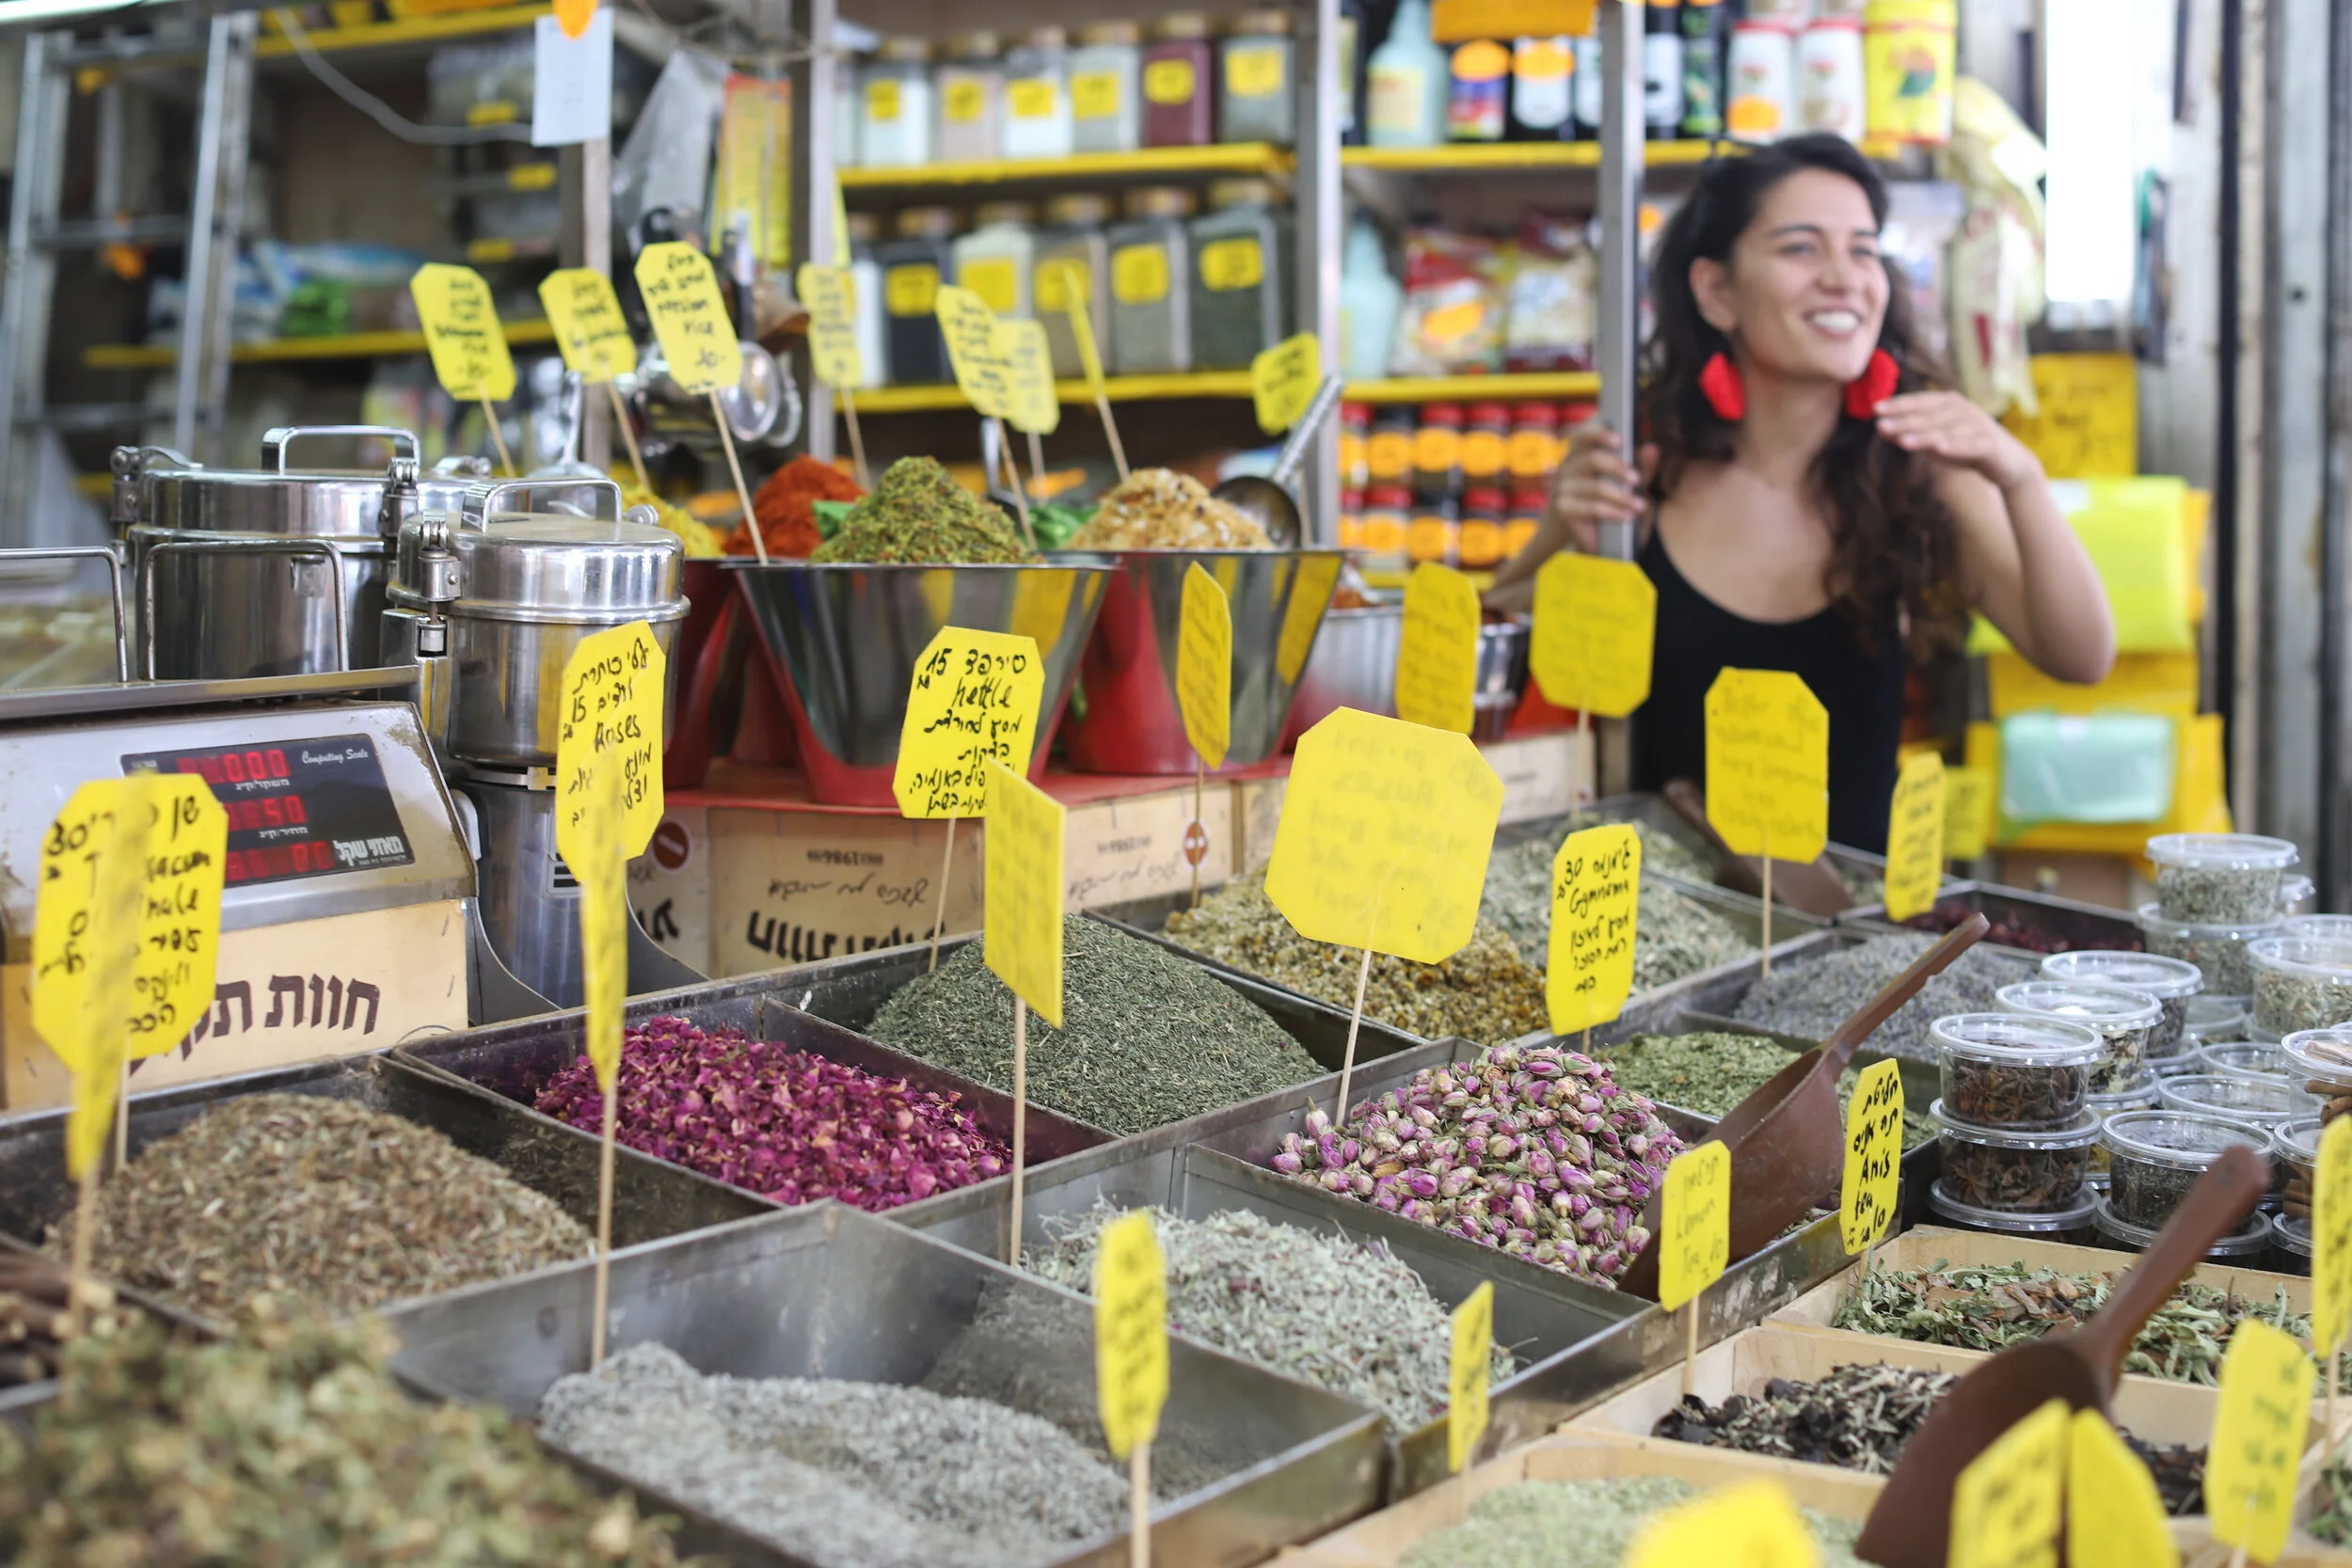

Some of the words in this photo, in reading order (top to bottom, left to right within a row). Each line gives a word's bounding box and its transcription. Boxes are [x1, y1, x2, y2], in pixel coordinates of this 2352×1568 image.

[926, 648, 952, 676] 15
[572, 695, 587, 723] 15
[302, 751, 344, 765] Computing
[345, 749, 369, 760] Scale
[47, 818, 87, 856] 30
[332, 840, 369, 866] שקל
[1565, 856, 1583, 885] 30
[264, 974, 380, 1035] חוות
[1859, 1147, 1891, 1187] Anis
[1873, 1204, 1886, 1233] 10
